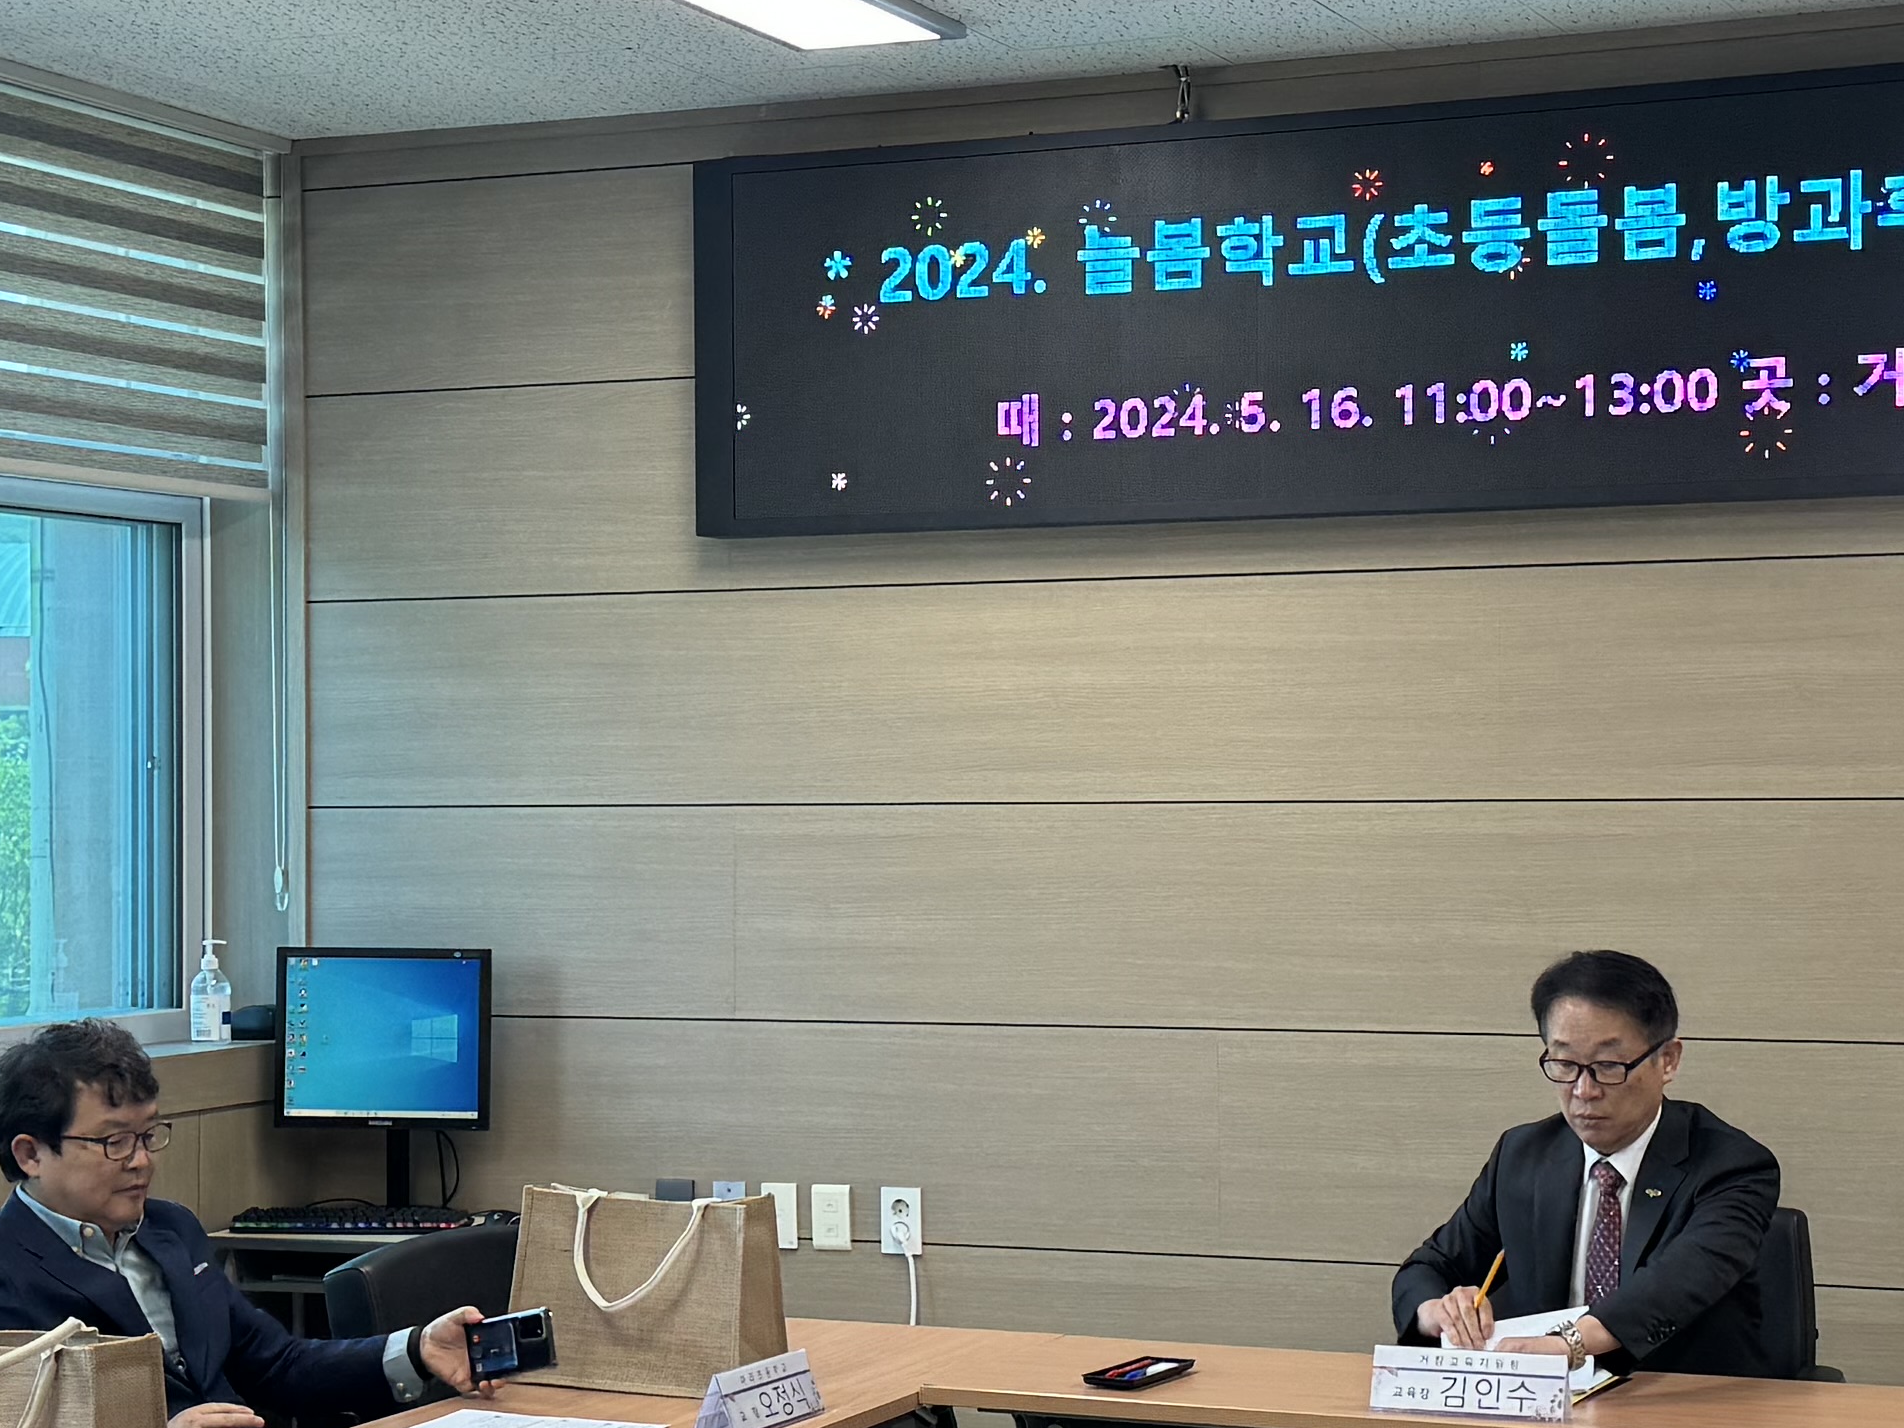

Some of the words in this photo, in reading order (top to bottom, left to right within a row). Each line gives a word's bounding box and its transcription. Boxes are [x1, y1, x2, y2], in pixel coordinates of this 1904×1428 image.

[879, 238, 1046, 303] 2024.
[997, 392, 1040, 447] 때
[1093, 392, 1220, 440] 2024.
[1239, 392, 1282, 434] 5.
[1302, 387, 1374, 430] 16.
[1395, 367, 1719, 427] 11:00~13:00
[1741, 356, 1794, 421] 곳
[758, 1378, 812, 1418] 오정식
[1440, 1375, 1537, 1413] 김인수
